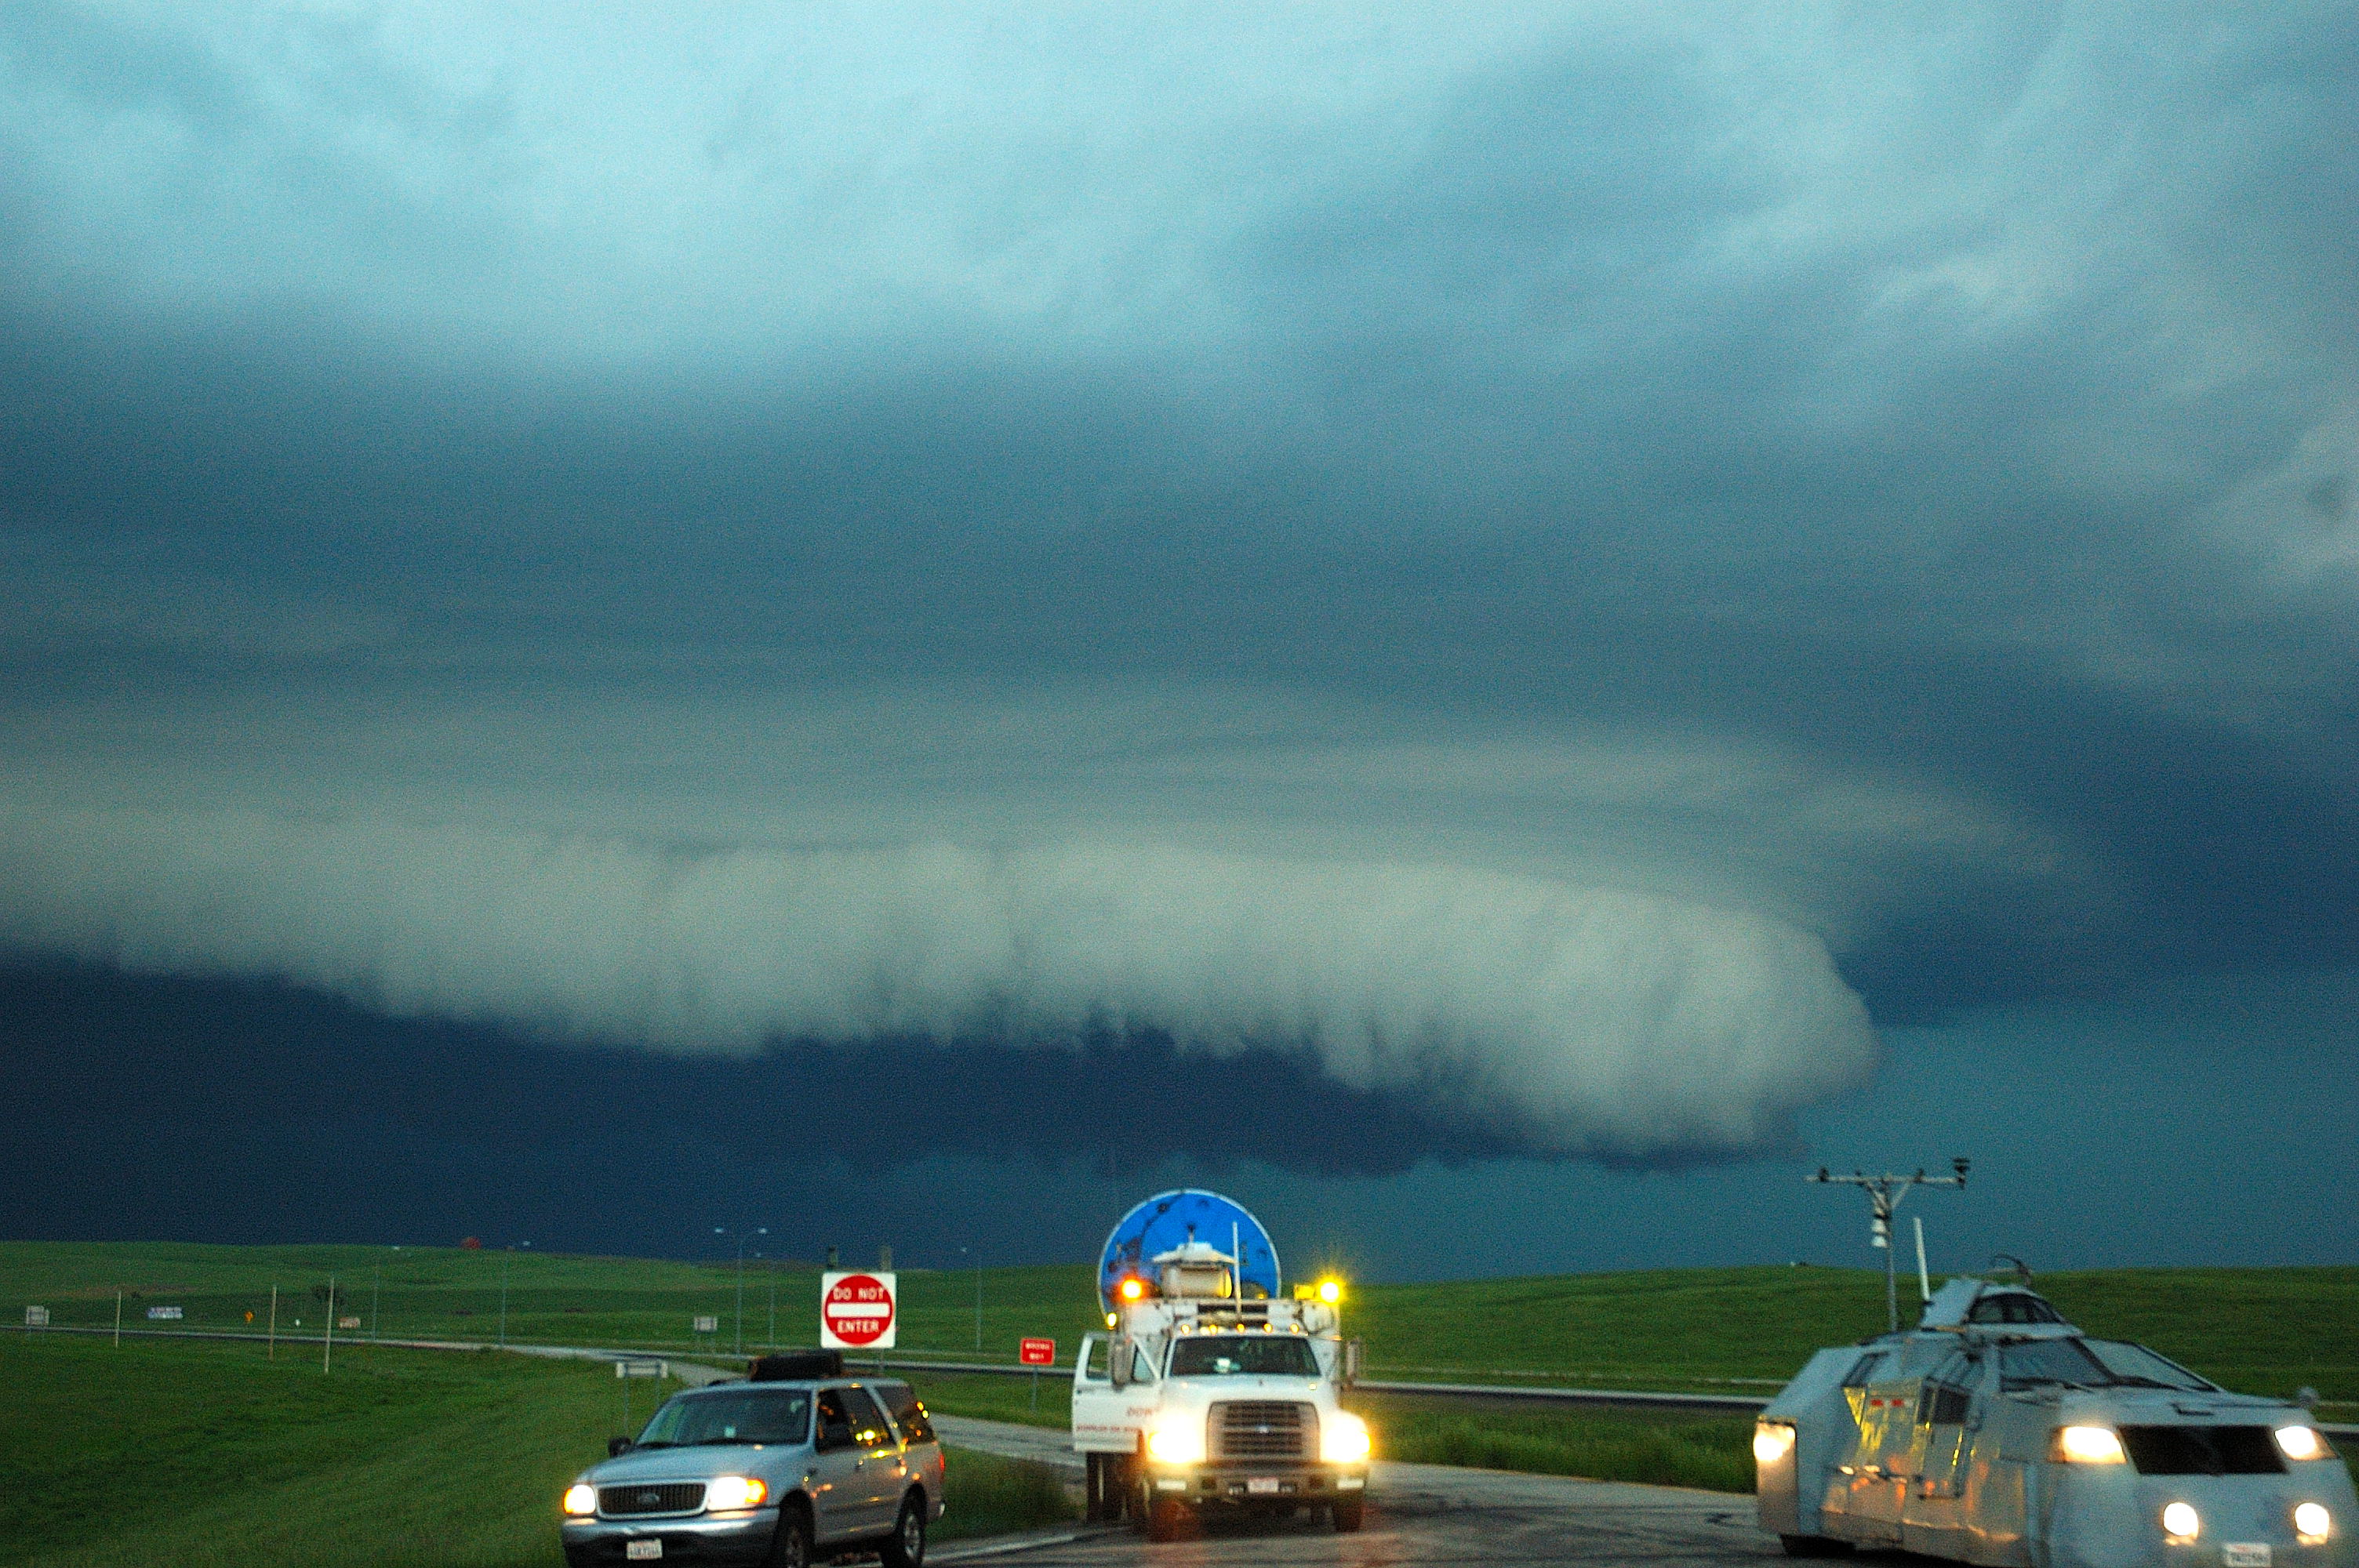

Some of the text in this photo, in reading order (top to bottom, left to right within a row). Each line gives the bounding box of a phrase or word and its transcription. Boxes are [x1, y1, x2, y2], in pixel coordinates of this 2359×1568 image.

[833, 1286, 885, 1301] DO NOT
[836, 1319, 880, 1334] ENTER
